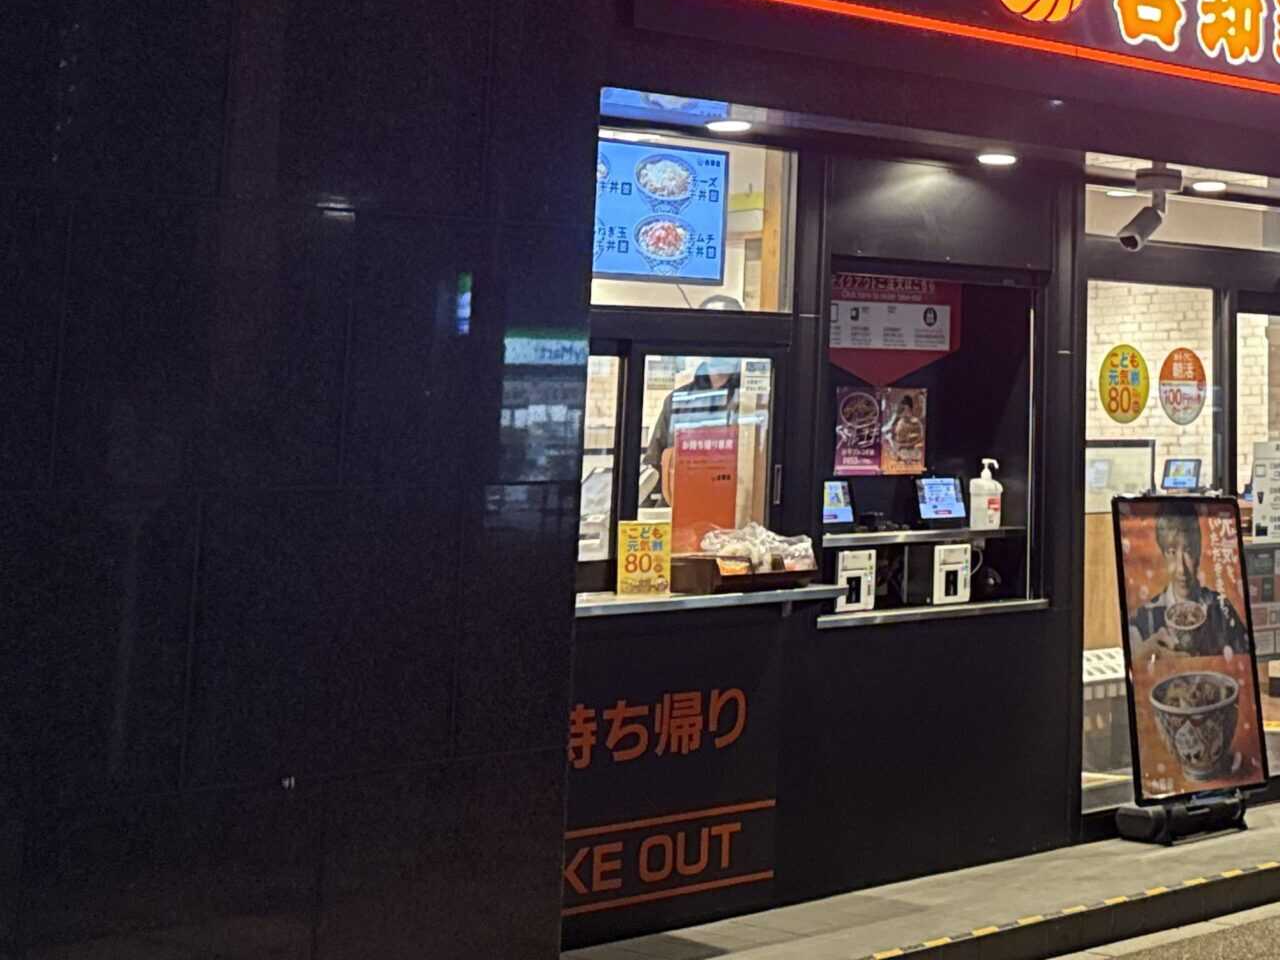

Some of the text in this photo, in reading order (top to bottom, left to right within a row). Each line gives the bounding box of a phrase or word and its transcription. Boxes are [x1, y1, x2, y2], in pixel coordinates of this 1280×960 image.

[1109, 352, 1140, 368] こども
[1108, 386, 1132, 414] 80
[627, 527, 664, 540] こども
[624, 553, 653, 573] 80
[638, 821, 743, 884] OUT
